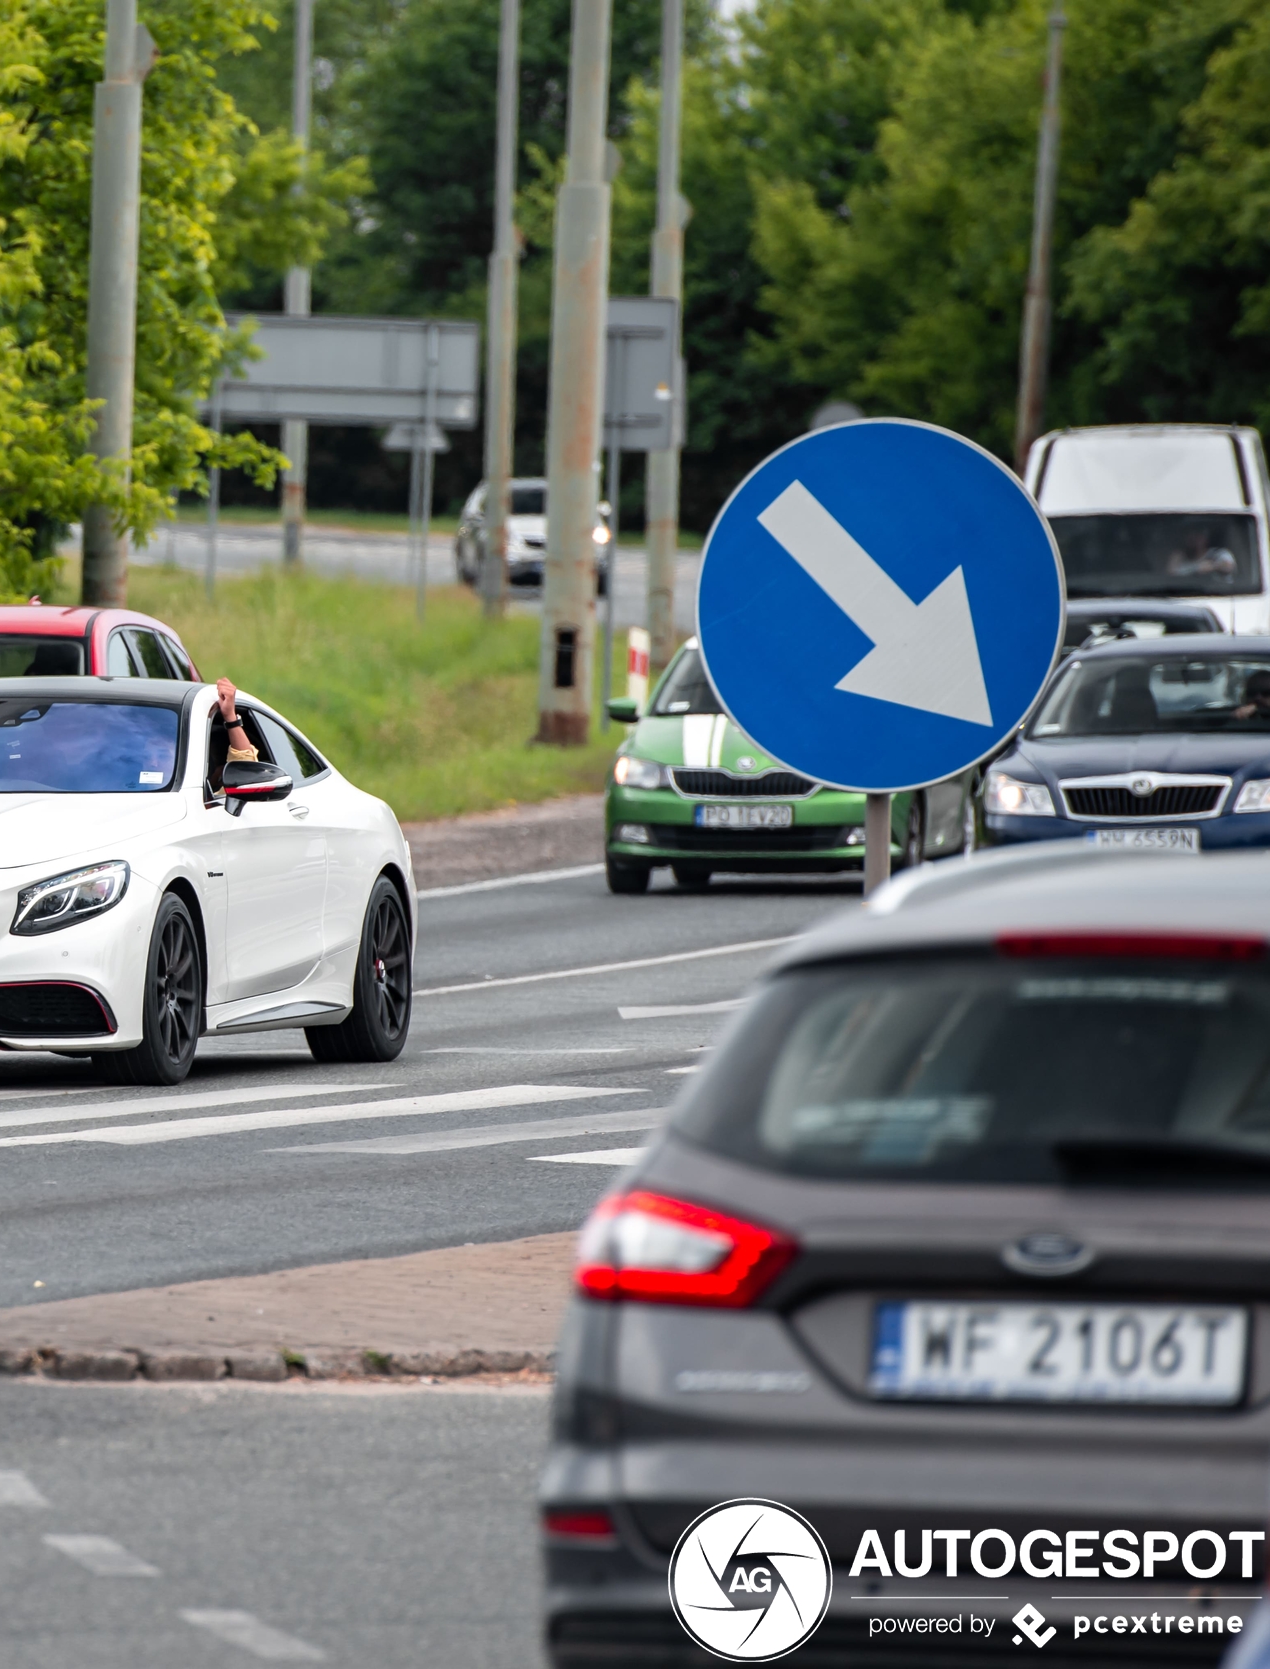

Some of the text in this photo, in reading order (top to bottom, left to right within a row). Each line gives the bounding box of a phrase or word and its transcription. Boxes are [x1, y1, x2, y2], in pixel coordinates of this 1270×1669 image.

[705, 805, 730, 822] PO
[1132, 829, 1194, 849] 6559N
[922, 1304, 1233, 1378] WF 2106T
